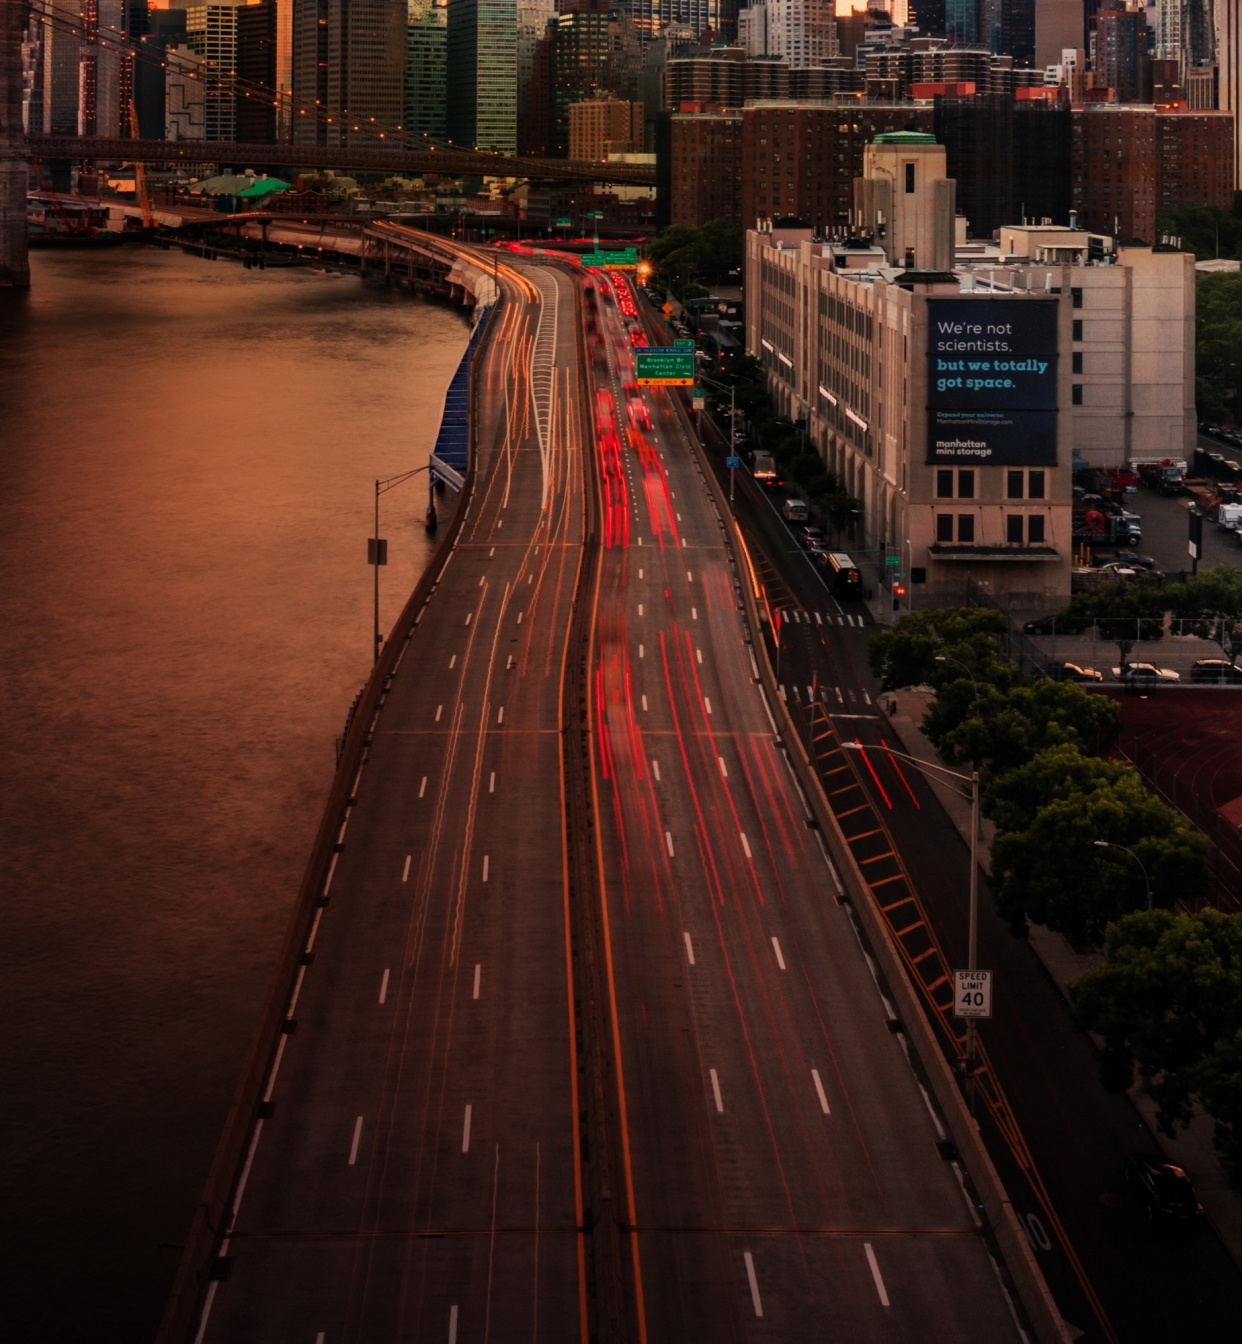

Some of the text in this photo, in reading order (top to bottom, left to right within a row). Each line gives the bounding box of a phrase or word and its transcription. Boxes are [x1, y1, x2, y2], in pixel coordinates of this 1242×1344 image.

[937, 321, 1012, 335] We're not
[937, 339, 1013, 352] scientists,
[937, 359, 1049, 374] but we totally
[937, 377, 1016, 391] got space.
[936, 438, 986, 448] manhattan
[936, 447, 992, 457] mini storage
[961, 992, 984, 1006] 40
